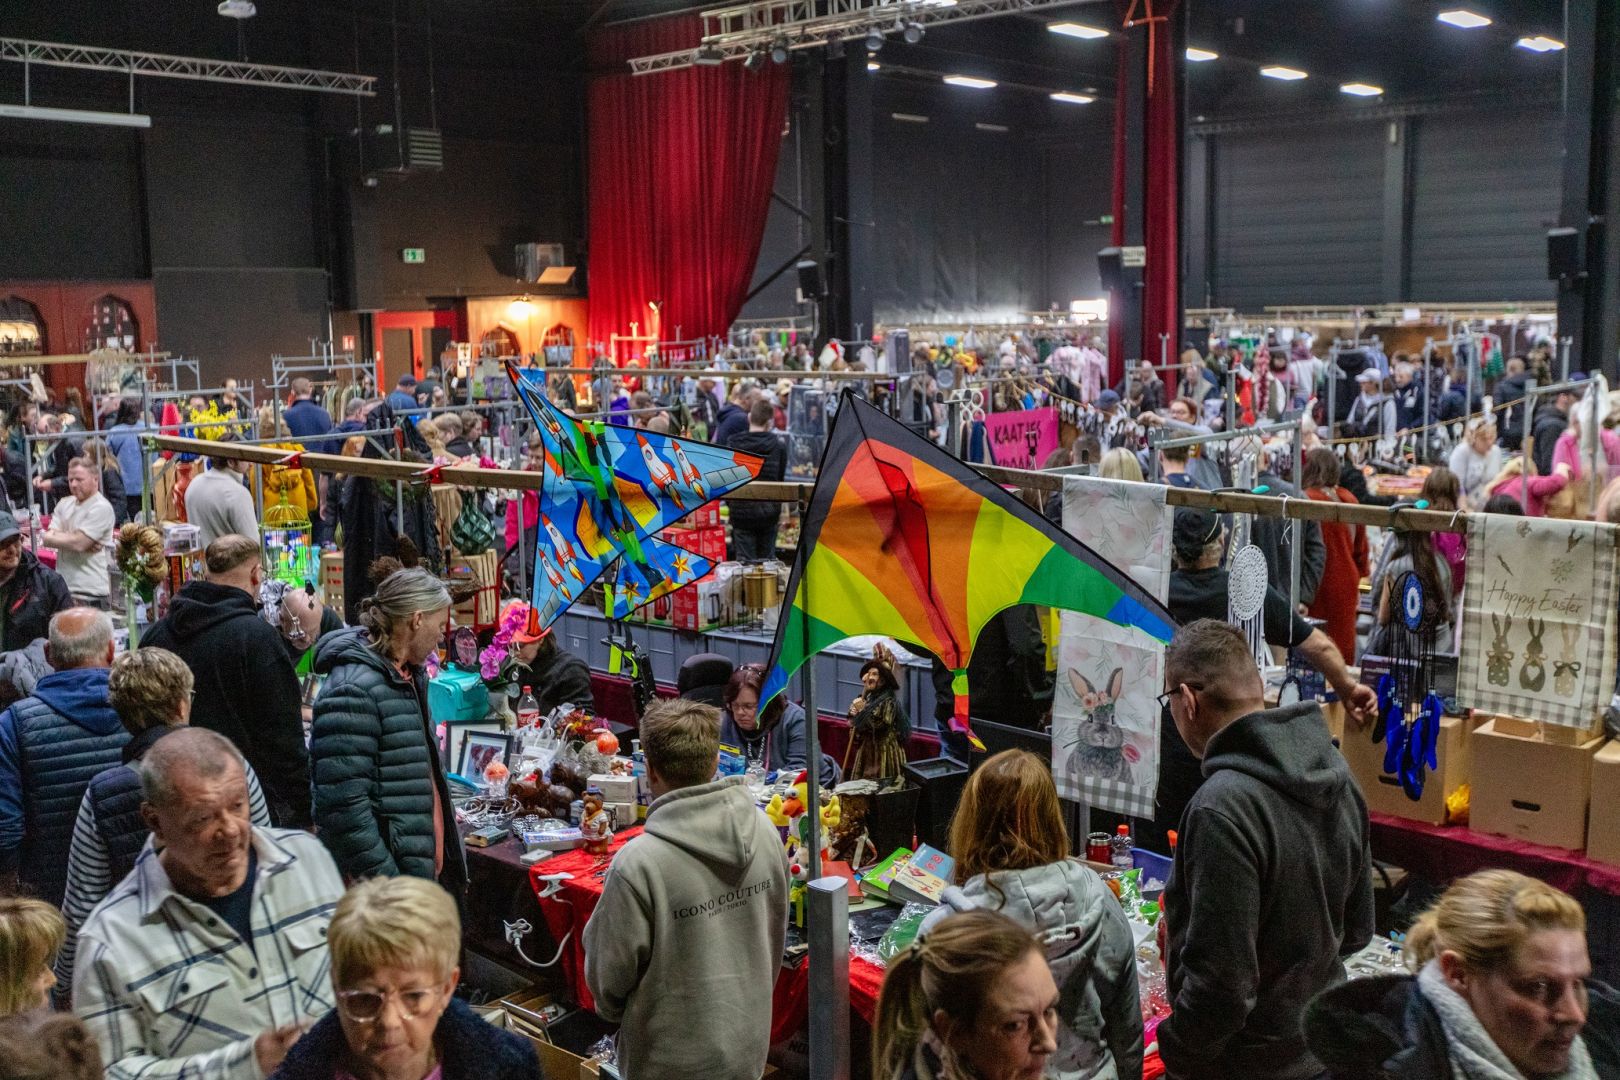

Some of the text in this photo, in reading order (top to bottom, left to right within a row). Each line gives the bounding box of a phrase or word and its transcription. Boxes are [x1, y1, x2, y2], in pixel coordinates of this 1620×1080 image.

[1487, 579, 1588, 617] Happy Easter
[673, 879, 772, 920] ICONO COUTURE
